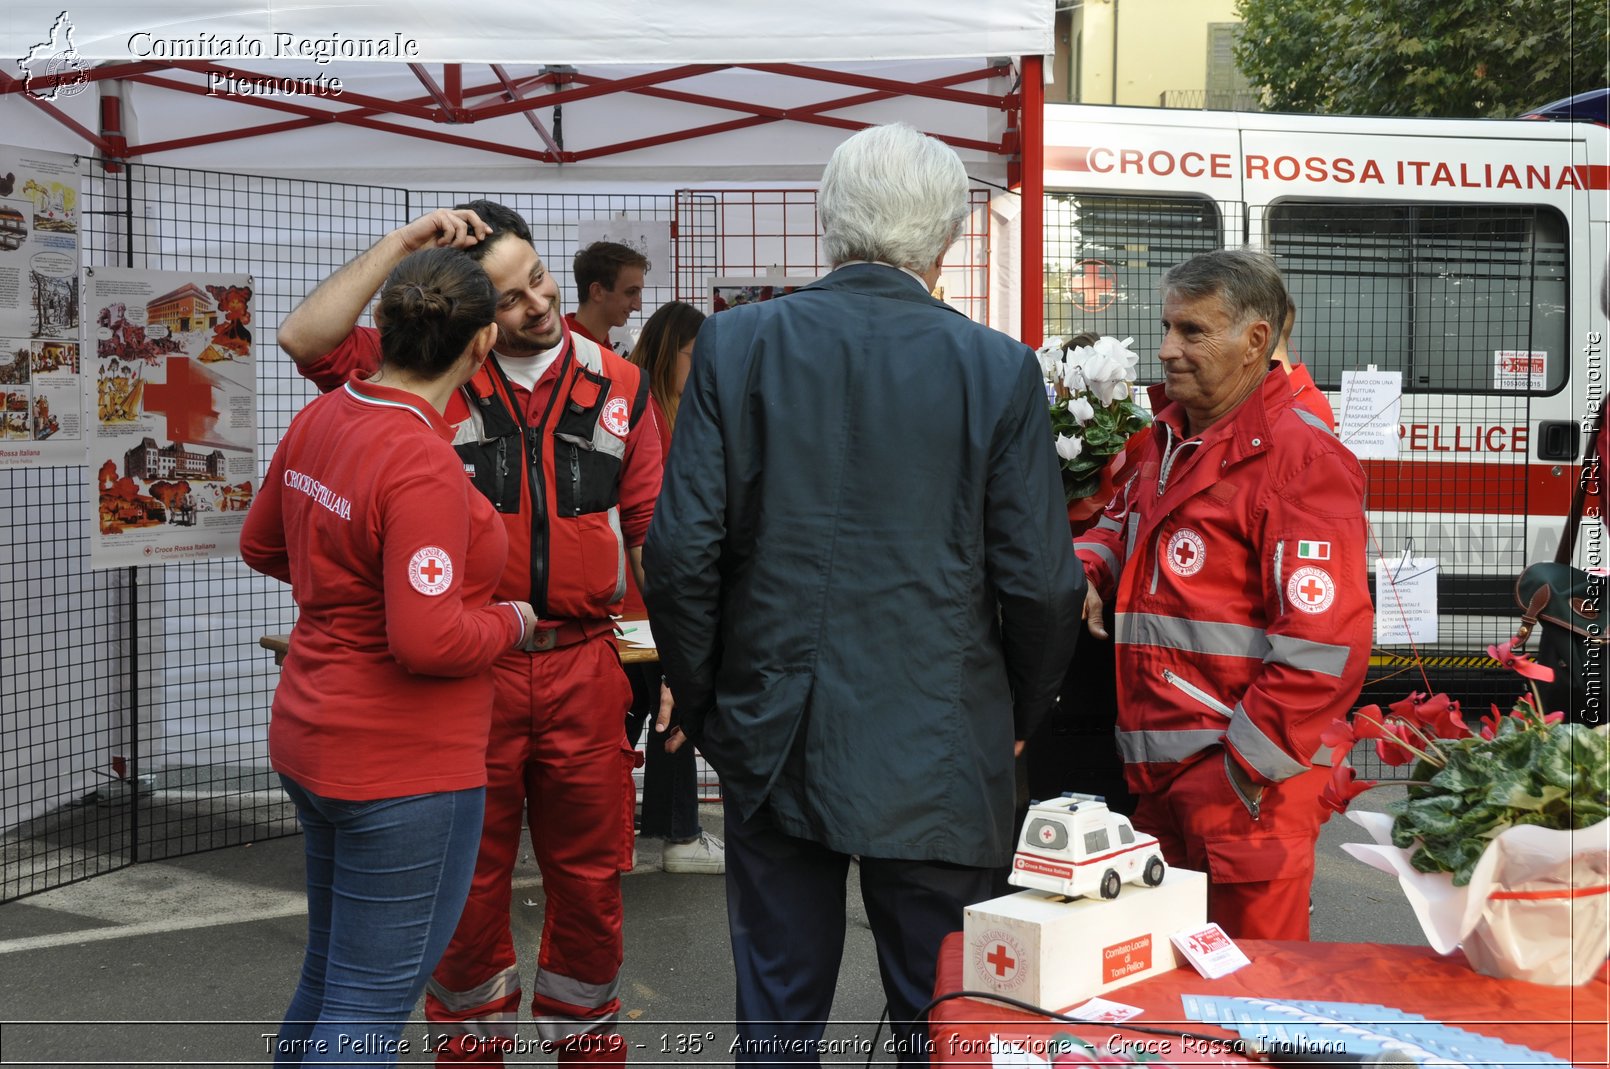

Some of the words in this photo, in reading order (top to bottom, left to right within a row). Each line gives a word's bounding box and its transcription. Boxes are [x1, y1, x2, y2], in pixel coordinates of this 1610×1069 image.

[1089, 147, 1233, 179] CROCE
[1245, 154, 1386, 184] ROSSA
[1397, 160, 1582, 191] ITALIANA
[1105, 945, 1131, 959] Comitato
[1131, 937, 1150, 951] Locale
[1124, 952, 1131, 963] di
[1111, 966, 1127, 978] Torre
